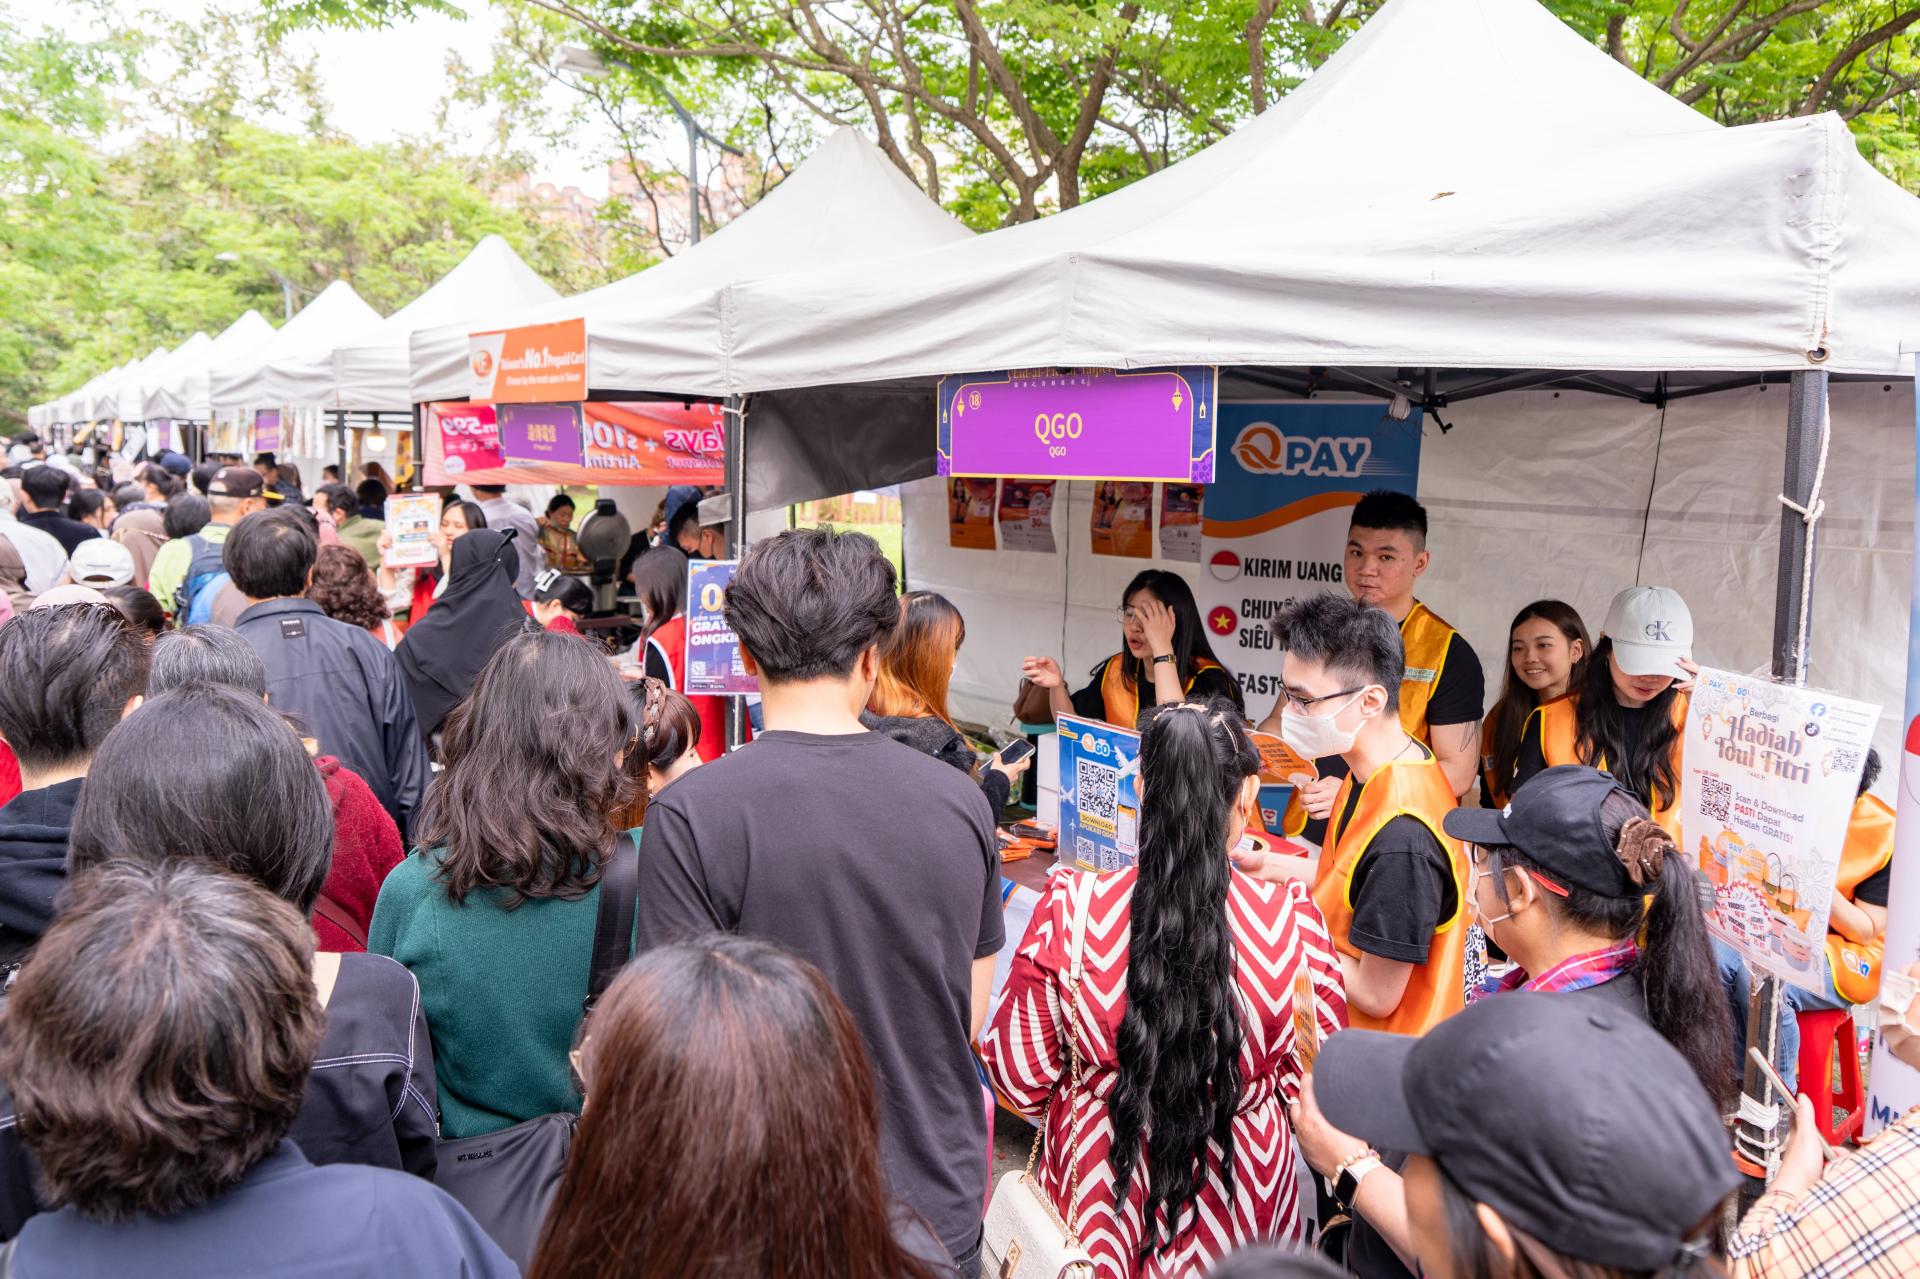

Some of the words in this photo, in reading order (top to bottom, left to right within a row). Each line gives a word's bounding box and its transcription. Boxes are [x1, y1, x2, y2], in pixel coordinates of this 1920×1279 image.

[525, 346, 549, 368] No.1
[970, 394, 980, 407] 18
[1034, 412, 1083, 445] QGO
[1049, 446, 1067, 457] QGO
[1243, 556, 1292, 579] KIRIM
[1296, 559, 1343, 584] UANG
[691, 620, 732, 633] GRAT
[1239, 624, 1274, 650] SIÊU
[1237, 672, 1279, 696] FAST
[1749, 706, 1779, 723] Berbagi
[1728, 714, 1802, 757] Hadiah
[1760, 750, 1811, 784] Fitri
[1734, 802, 1756, 819] PASTI
[1757, 811, 1782, 828] Dapat
[1735, 791, 1752, 805] Scan
[1753, 798, 1760, 808] &
[1761, 801, 1805, 824] Download
[1081, 814, 1113, 830] DOWNLOAD
[1733, 814, 1761, 832] Hadiah
[1762, 826, 1793, 845] GRATIS!
